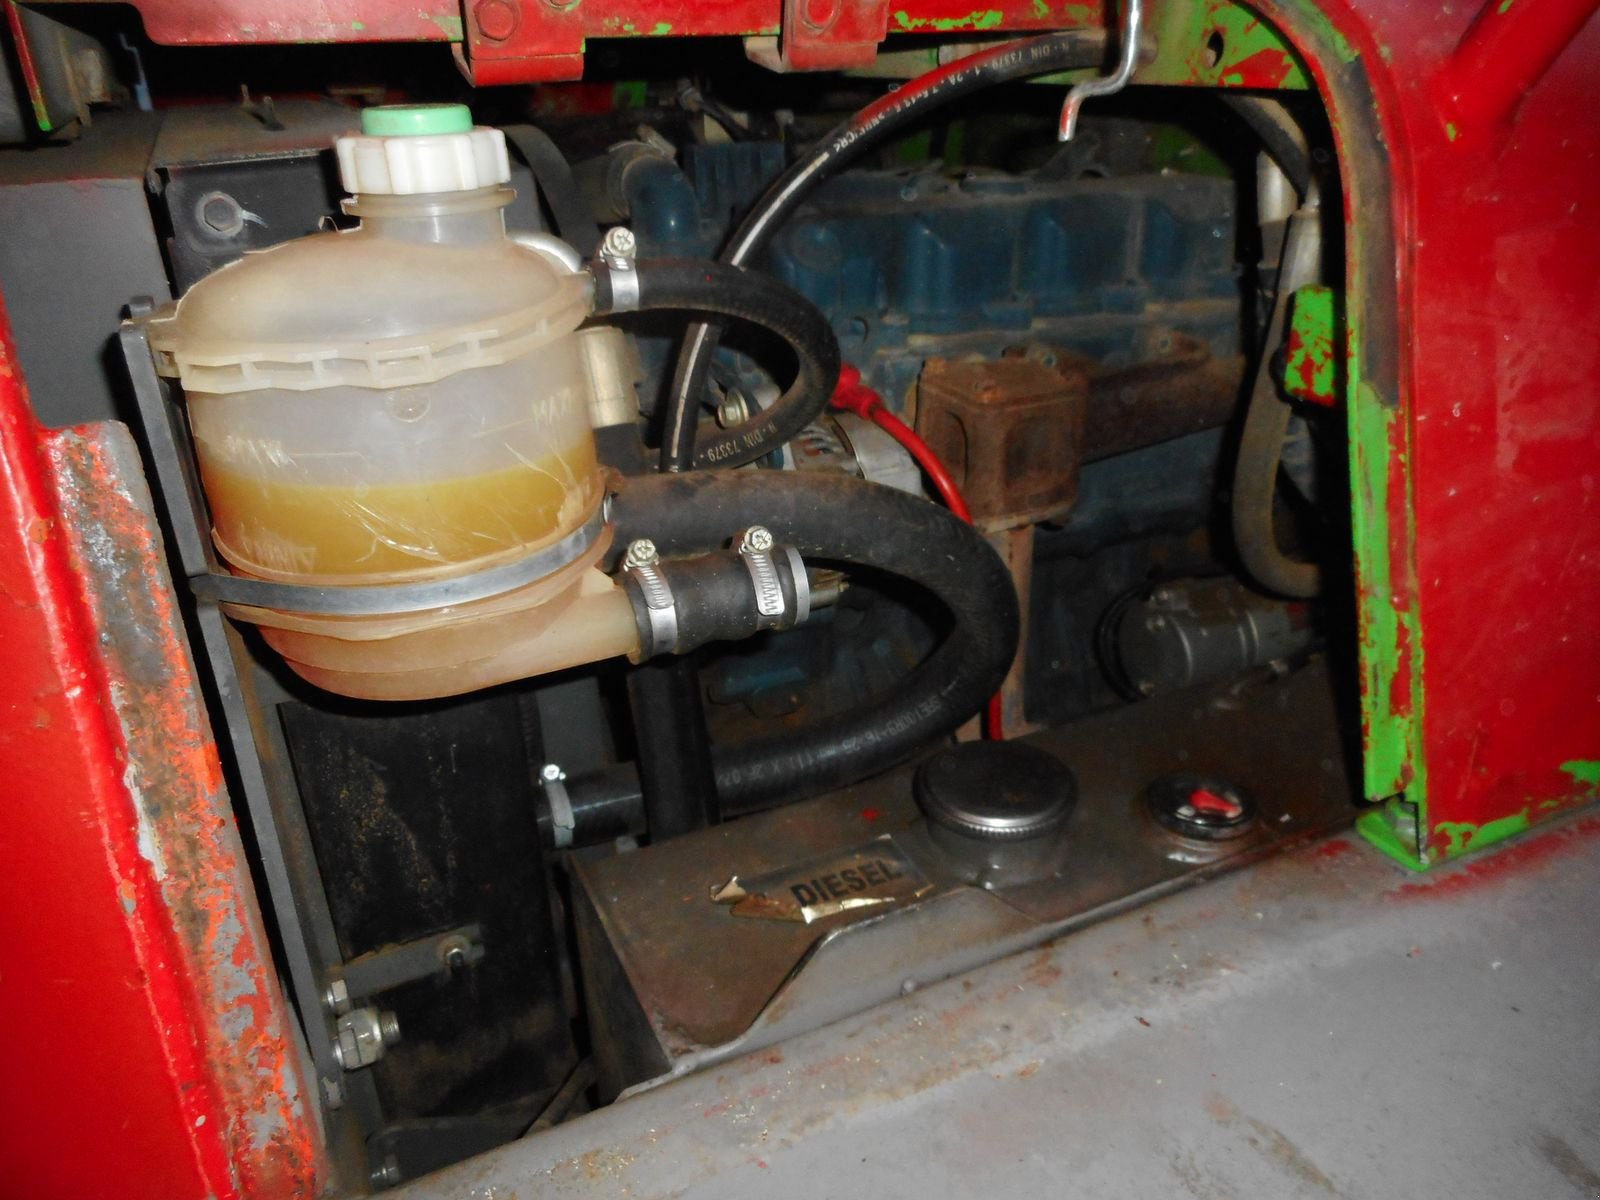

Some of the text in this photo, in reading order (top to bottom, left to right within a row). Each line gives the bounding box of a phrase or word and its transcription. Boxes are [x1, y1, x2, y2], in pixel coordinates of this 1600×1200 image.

[742, 428, 764, 448] DIN
[706, 440, 741, 462] 73379
[790, 859, 904, 907] DIESEL
